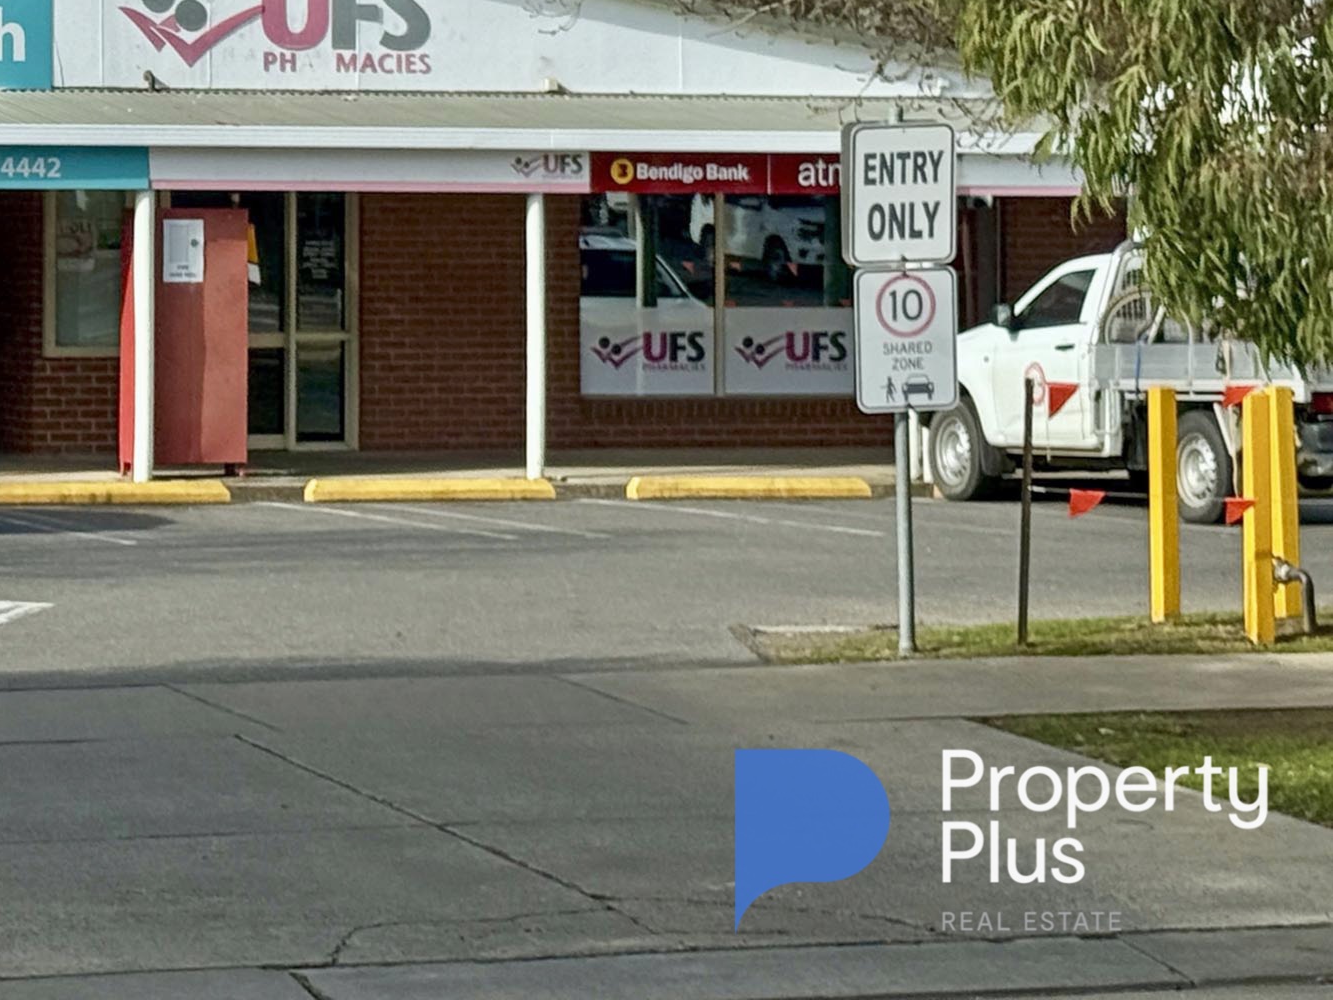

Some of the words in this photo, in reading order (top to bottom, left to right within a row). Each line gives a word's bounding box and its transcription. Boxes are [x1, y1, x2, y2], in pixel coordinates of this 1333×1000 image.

[0, 156, 62, 179] 4442
[543, 153, 583, 175] UFS
[635, 162, 704, 184] Bendigo
[706, 163, 749, 182] Bank
[863, 150, 944, 187] ENTRY
[867, 201, 940, 242] ONLY
[889, 289, 923, 322] 10
[642, 331, 706, 363] UFS
[785, 331, 848, 363] UFS
[883, 341, 933, 355] SHARED
[892, 356, 924, 371] ZONE
